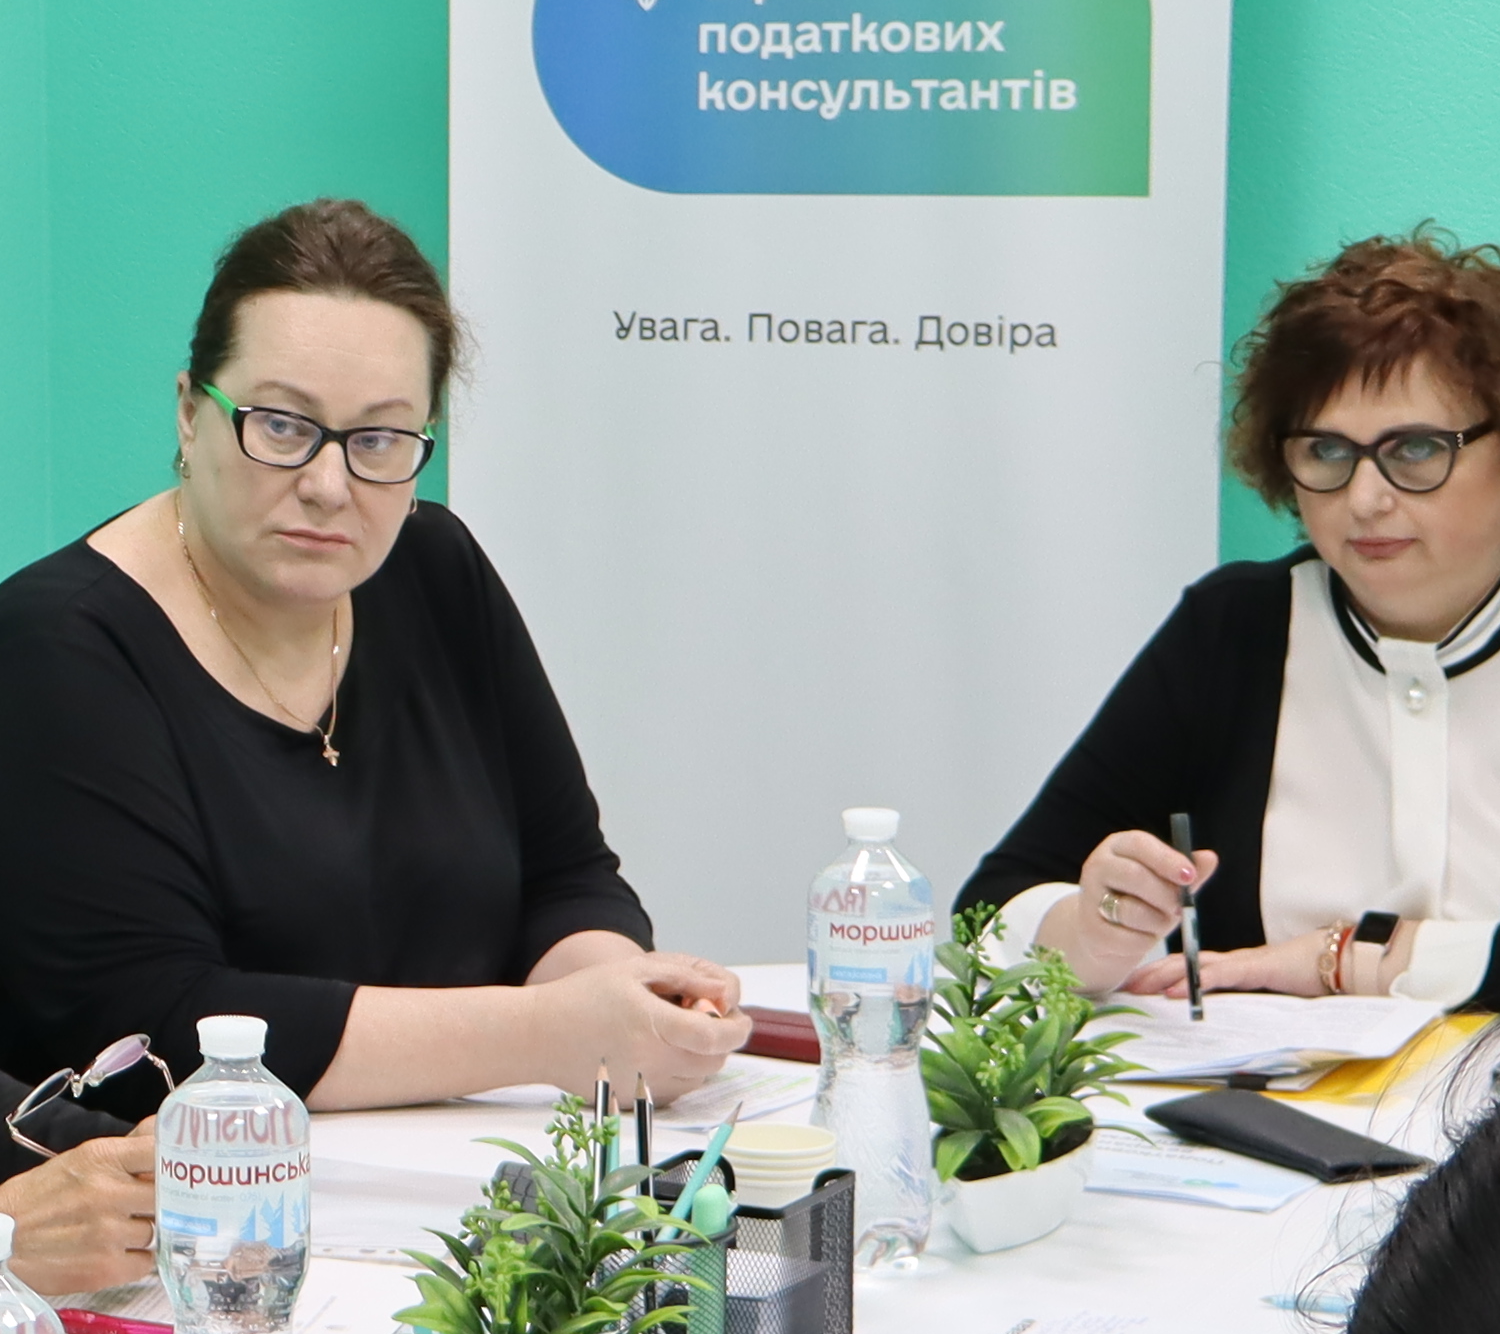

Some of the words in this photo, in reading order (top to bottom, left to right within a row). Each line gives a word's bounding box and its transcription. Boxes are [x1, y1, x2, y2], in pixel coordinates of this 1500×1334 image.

[699, 13, 1005, 59] податкових
[698, 69, 1078, 121] консультантів
[612, 310, 731, 343] Увага.
[748, 312, 900, 346] Повага.
[914, 315, 1057, 354] Довіра
